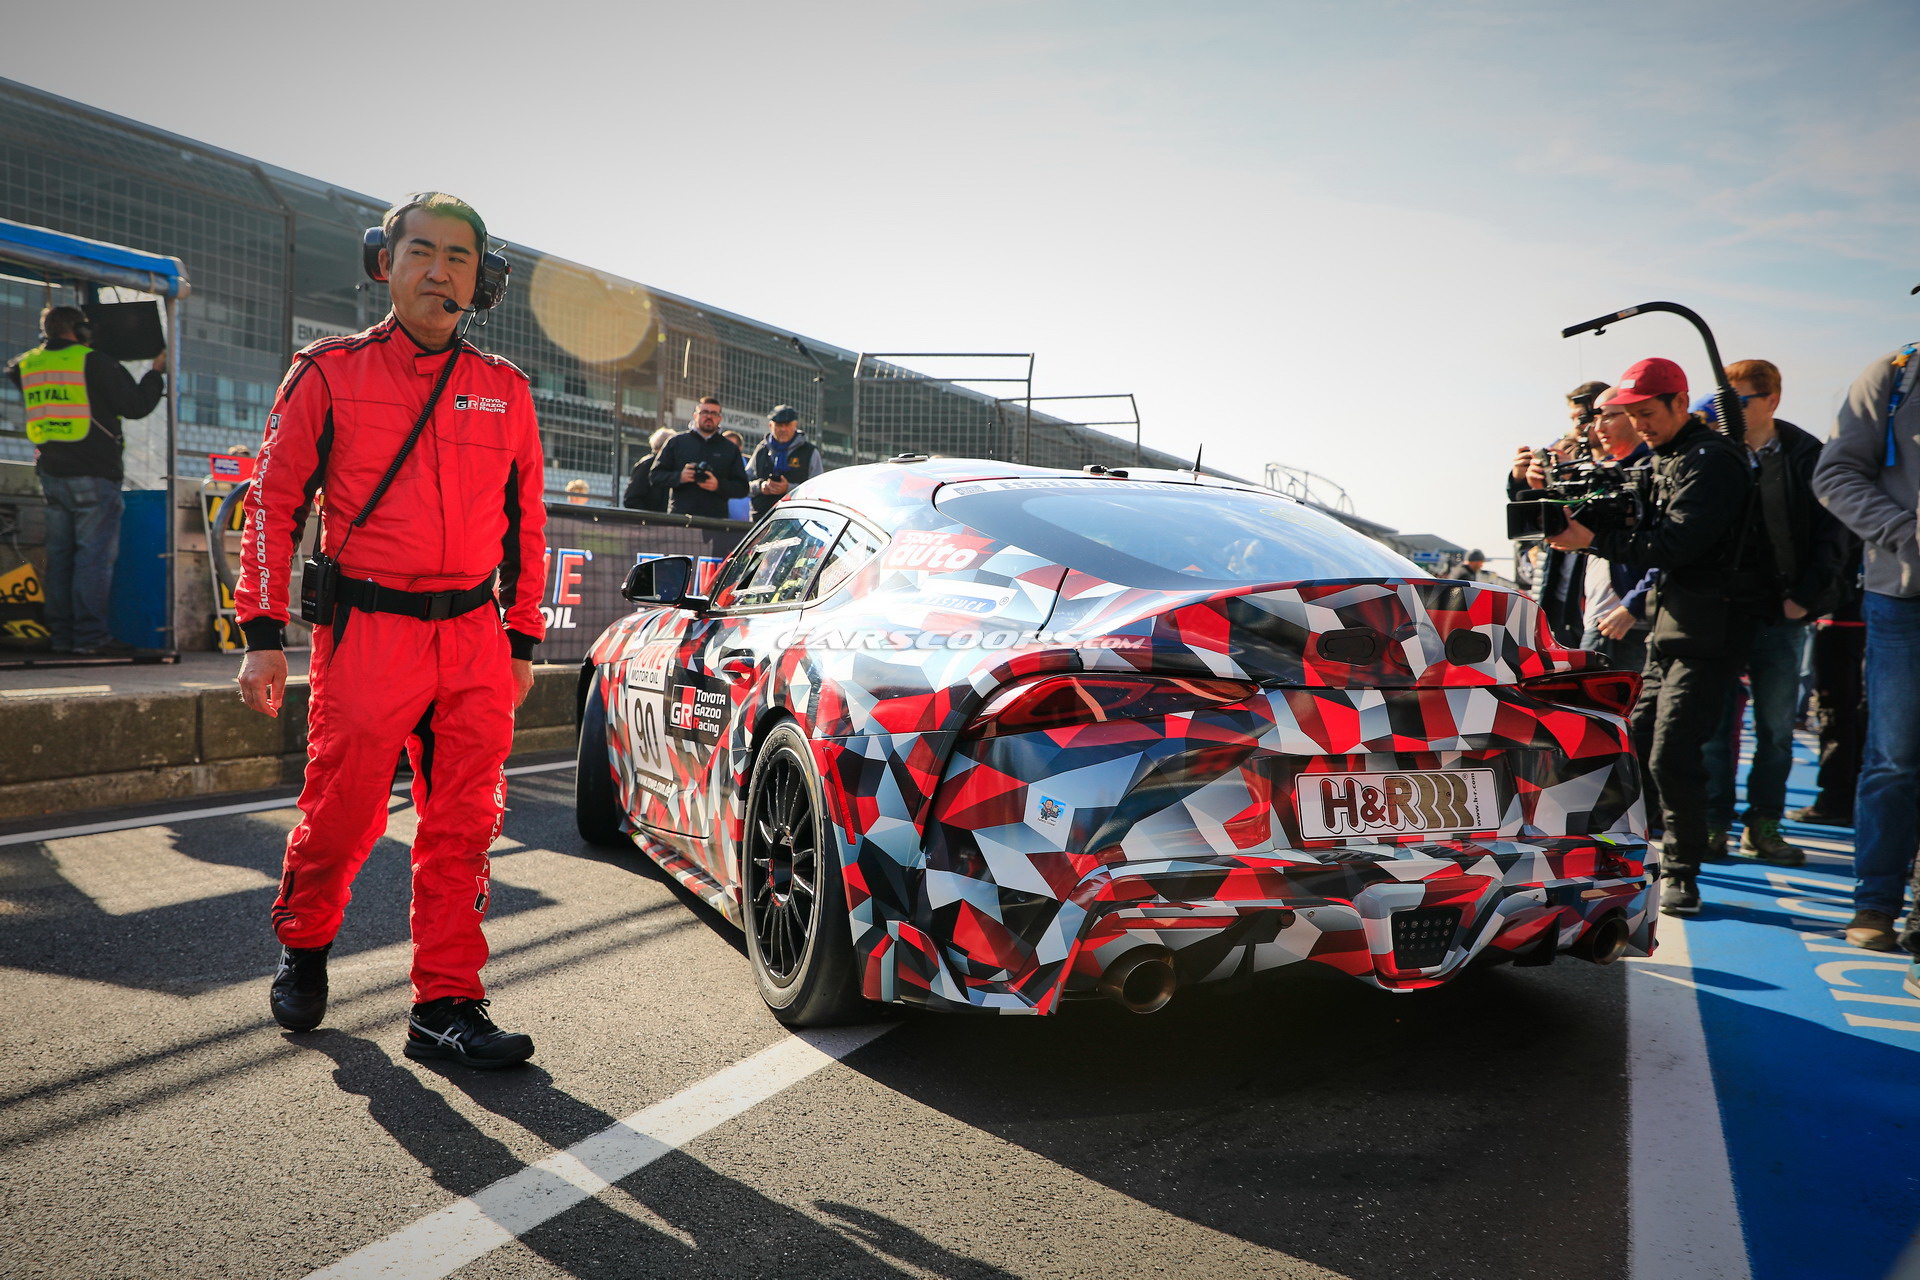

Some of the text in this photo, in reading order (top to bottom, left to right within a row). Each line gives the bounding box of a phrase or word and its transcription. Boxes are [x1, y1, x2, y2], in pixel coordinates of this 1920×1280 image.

[900, 533, 952, 546] sport
[887, 543, 979, 571] auto
[258, 565, 271, 610] Racing
[631, 669, 660, 684] MOTOR OIL
[696, 688, 726, 706] TOYOTA
[671, 701, 693, 728] GR
[693, 703, 722, 720] GAZOO
[634, 697, 662, 770] 90
[692, 716, 720, 738] Racing
